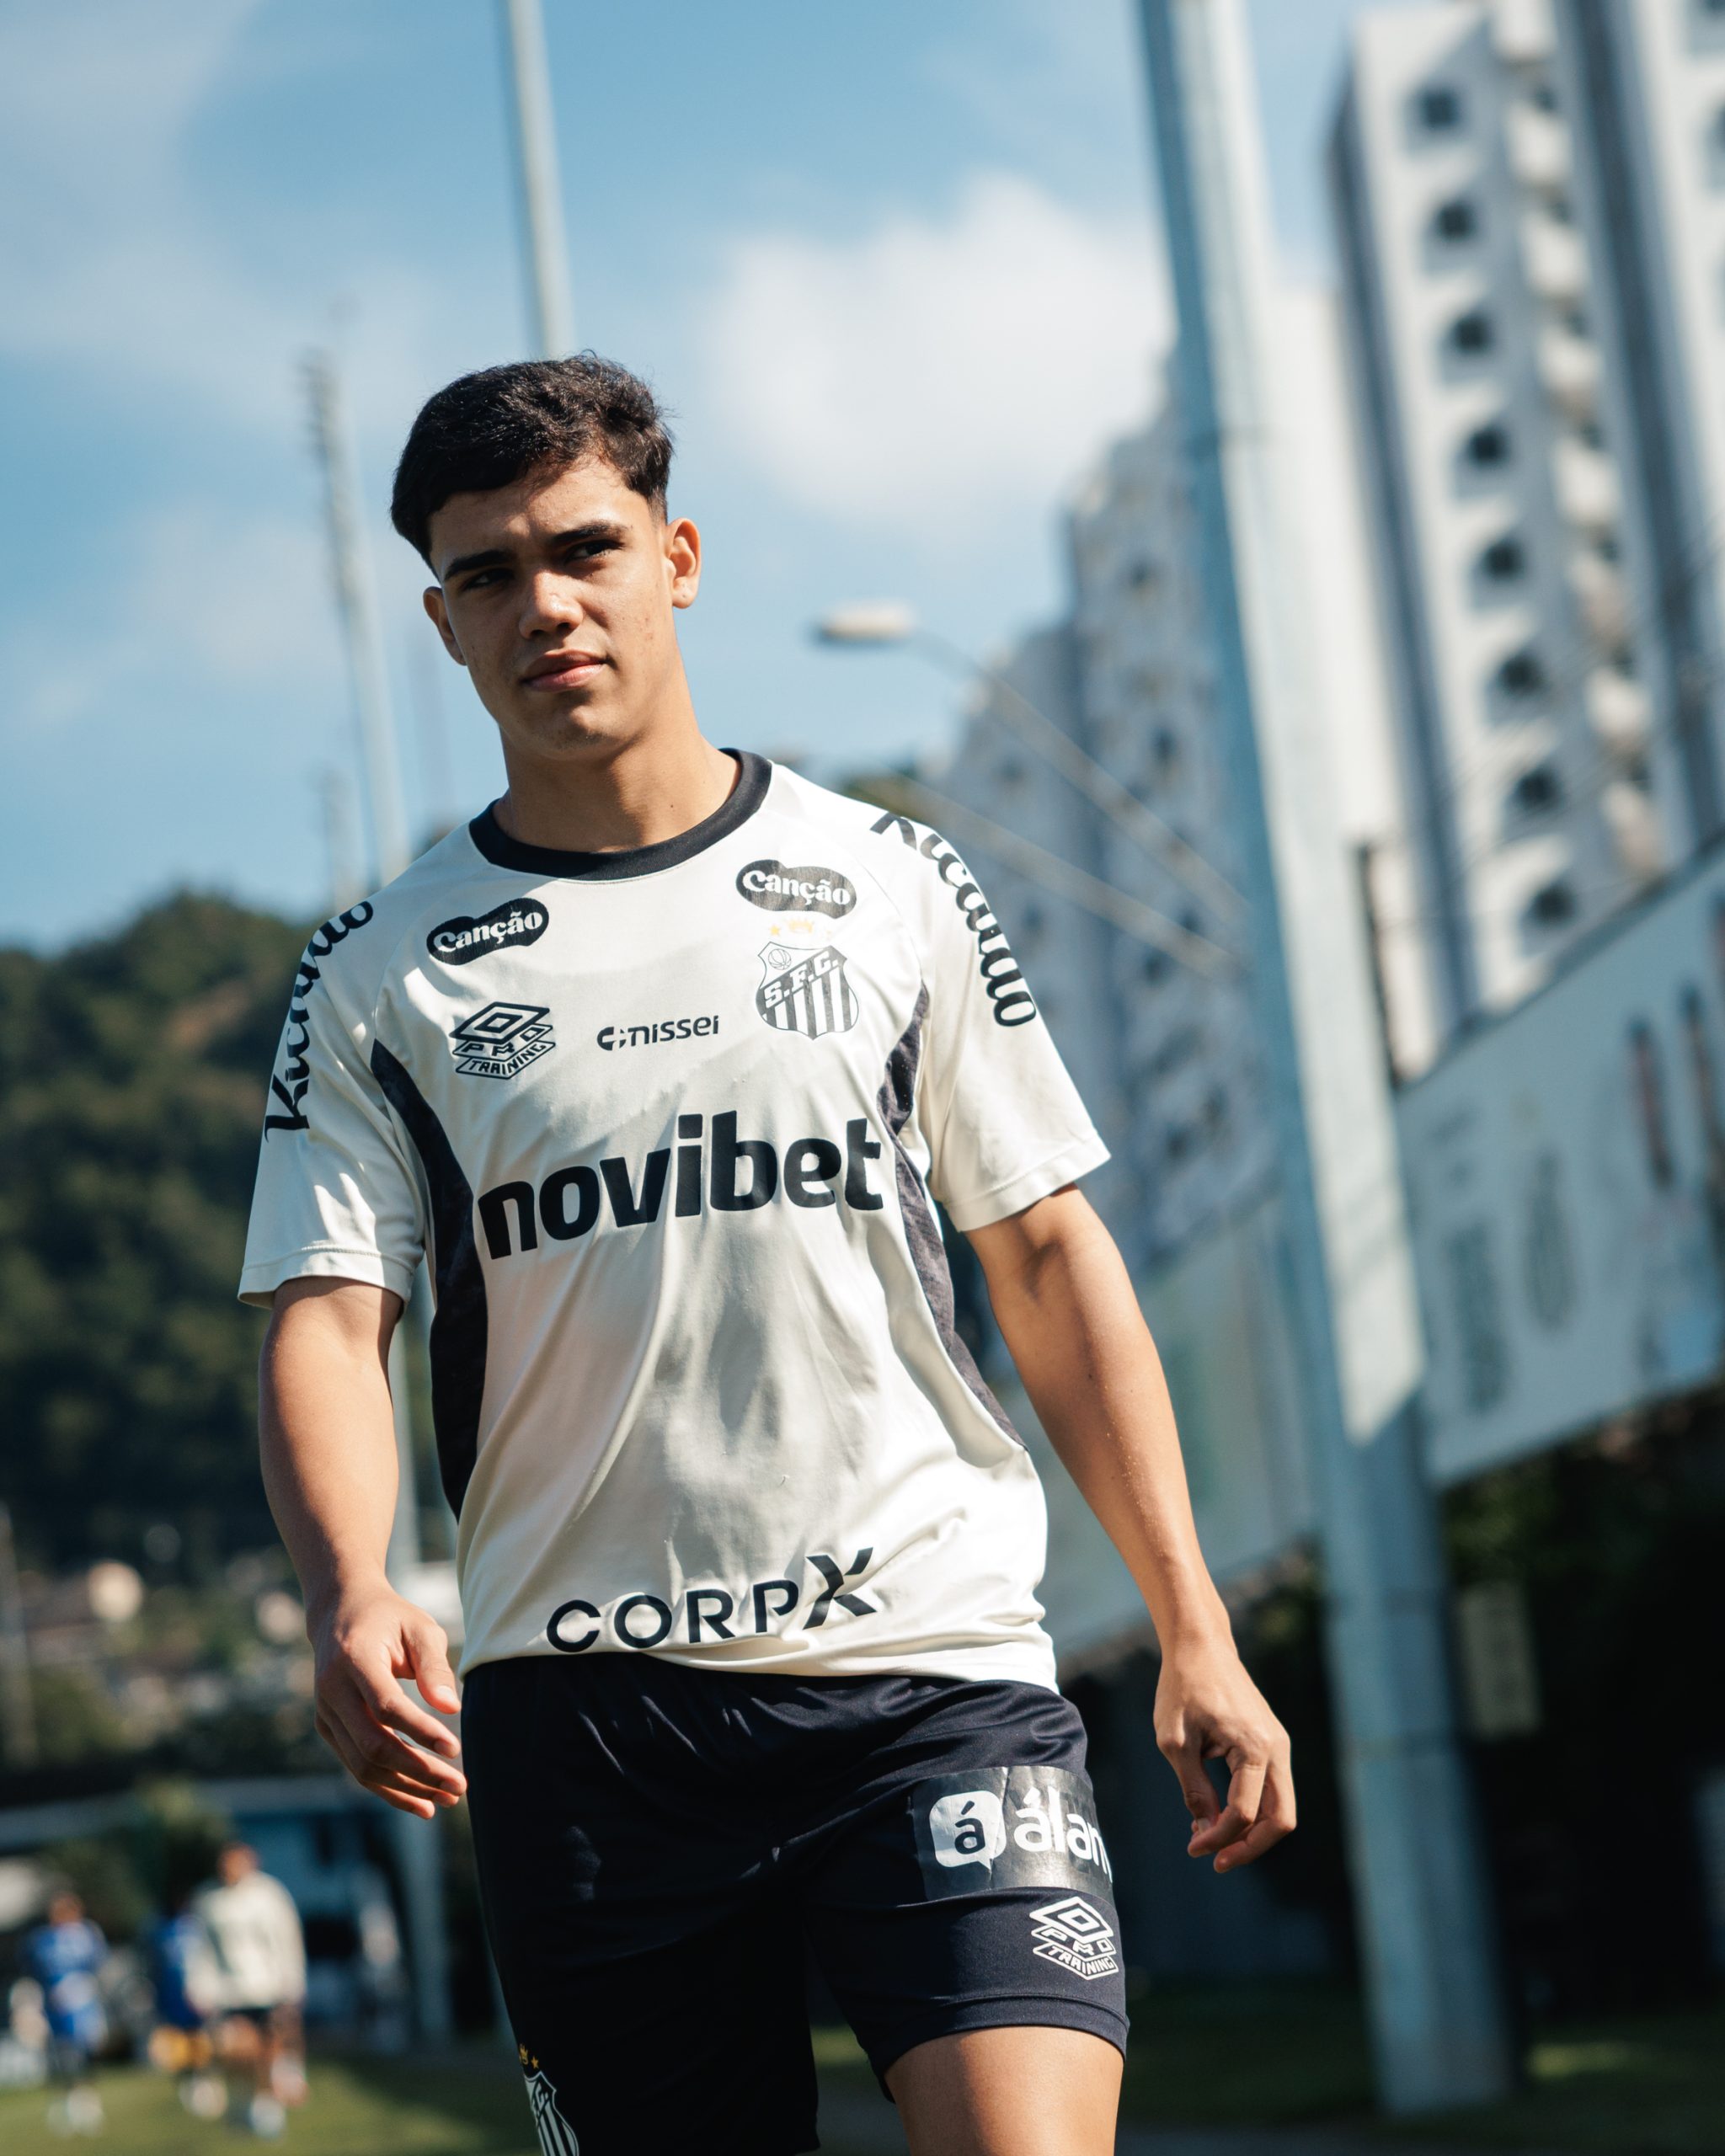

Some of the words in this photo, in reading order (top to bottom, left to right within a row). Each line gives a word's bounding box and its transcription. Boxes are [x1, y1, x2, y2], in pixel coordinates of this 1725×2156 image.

[743, 869, 851, 905] Canção
[433, 911, 543, 953] Canção
[763, 950, 839, 1009] S.F.C.
[461, 1026, 546, 1056] PRO
[628, 1015, 719, 1047] nissei
[468, 1043, 547, 1075] TRAINING
[478, 1110, 884, 1260] novibet
[547, 1546, 877, 1652] CORPX
[954, 1801, 985, 1854] á
[1041, 1927, 1114, 1956] PRO
[1048, 1945, 1114, 1975] TRAINING
